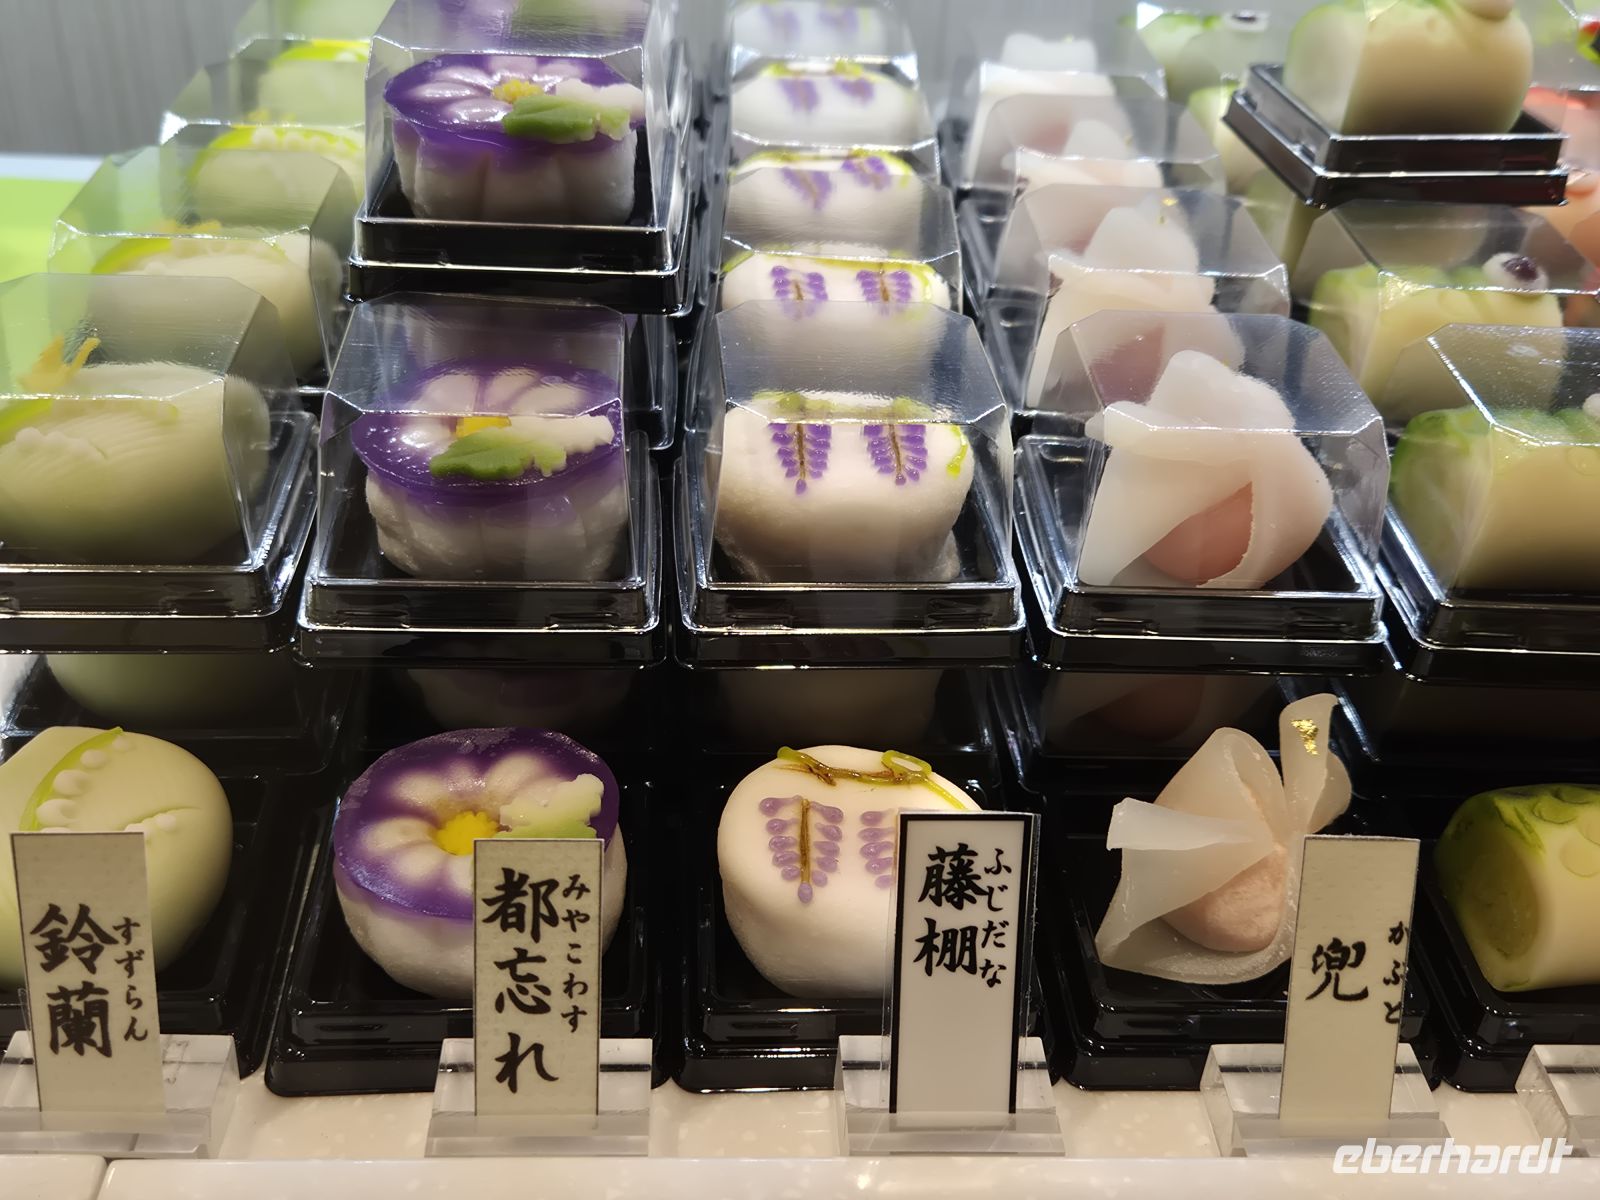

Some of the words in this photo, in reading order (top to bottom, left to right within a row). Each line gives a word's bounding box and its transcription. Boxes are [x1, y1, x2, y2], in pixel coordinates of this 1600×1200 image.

[560, 874, 591, 1032] みやこわす
[913, 843, 987, 976] 藤棚
[980, 848, 1012, 988] ふじだな
[1305, 937, 1369, 1002] 兜
[1383, 921, 1409, 1024] かぶと
[30, 903, 118, 1057] 鈴蘭
[112, 917, 148, 1042] すずらん
[482, 867, 559, 1093] 都忘れ
